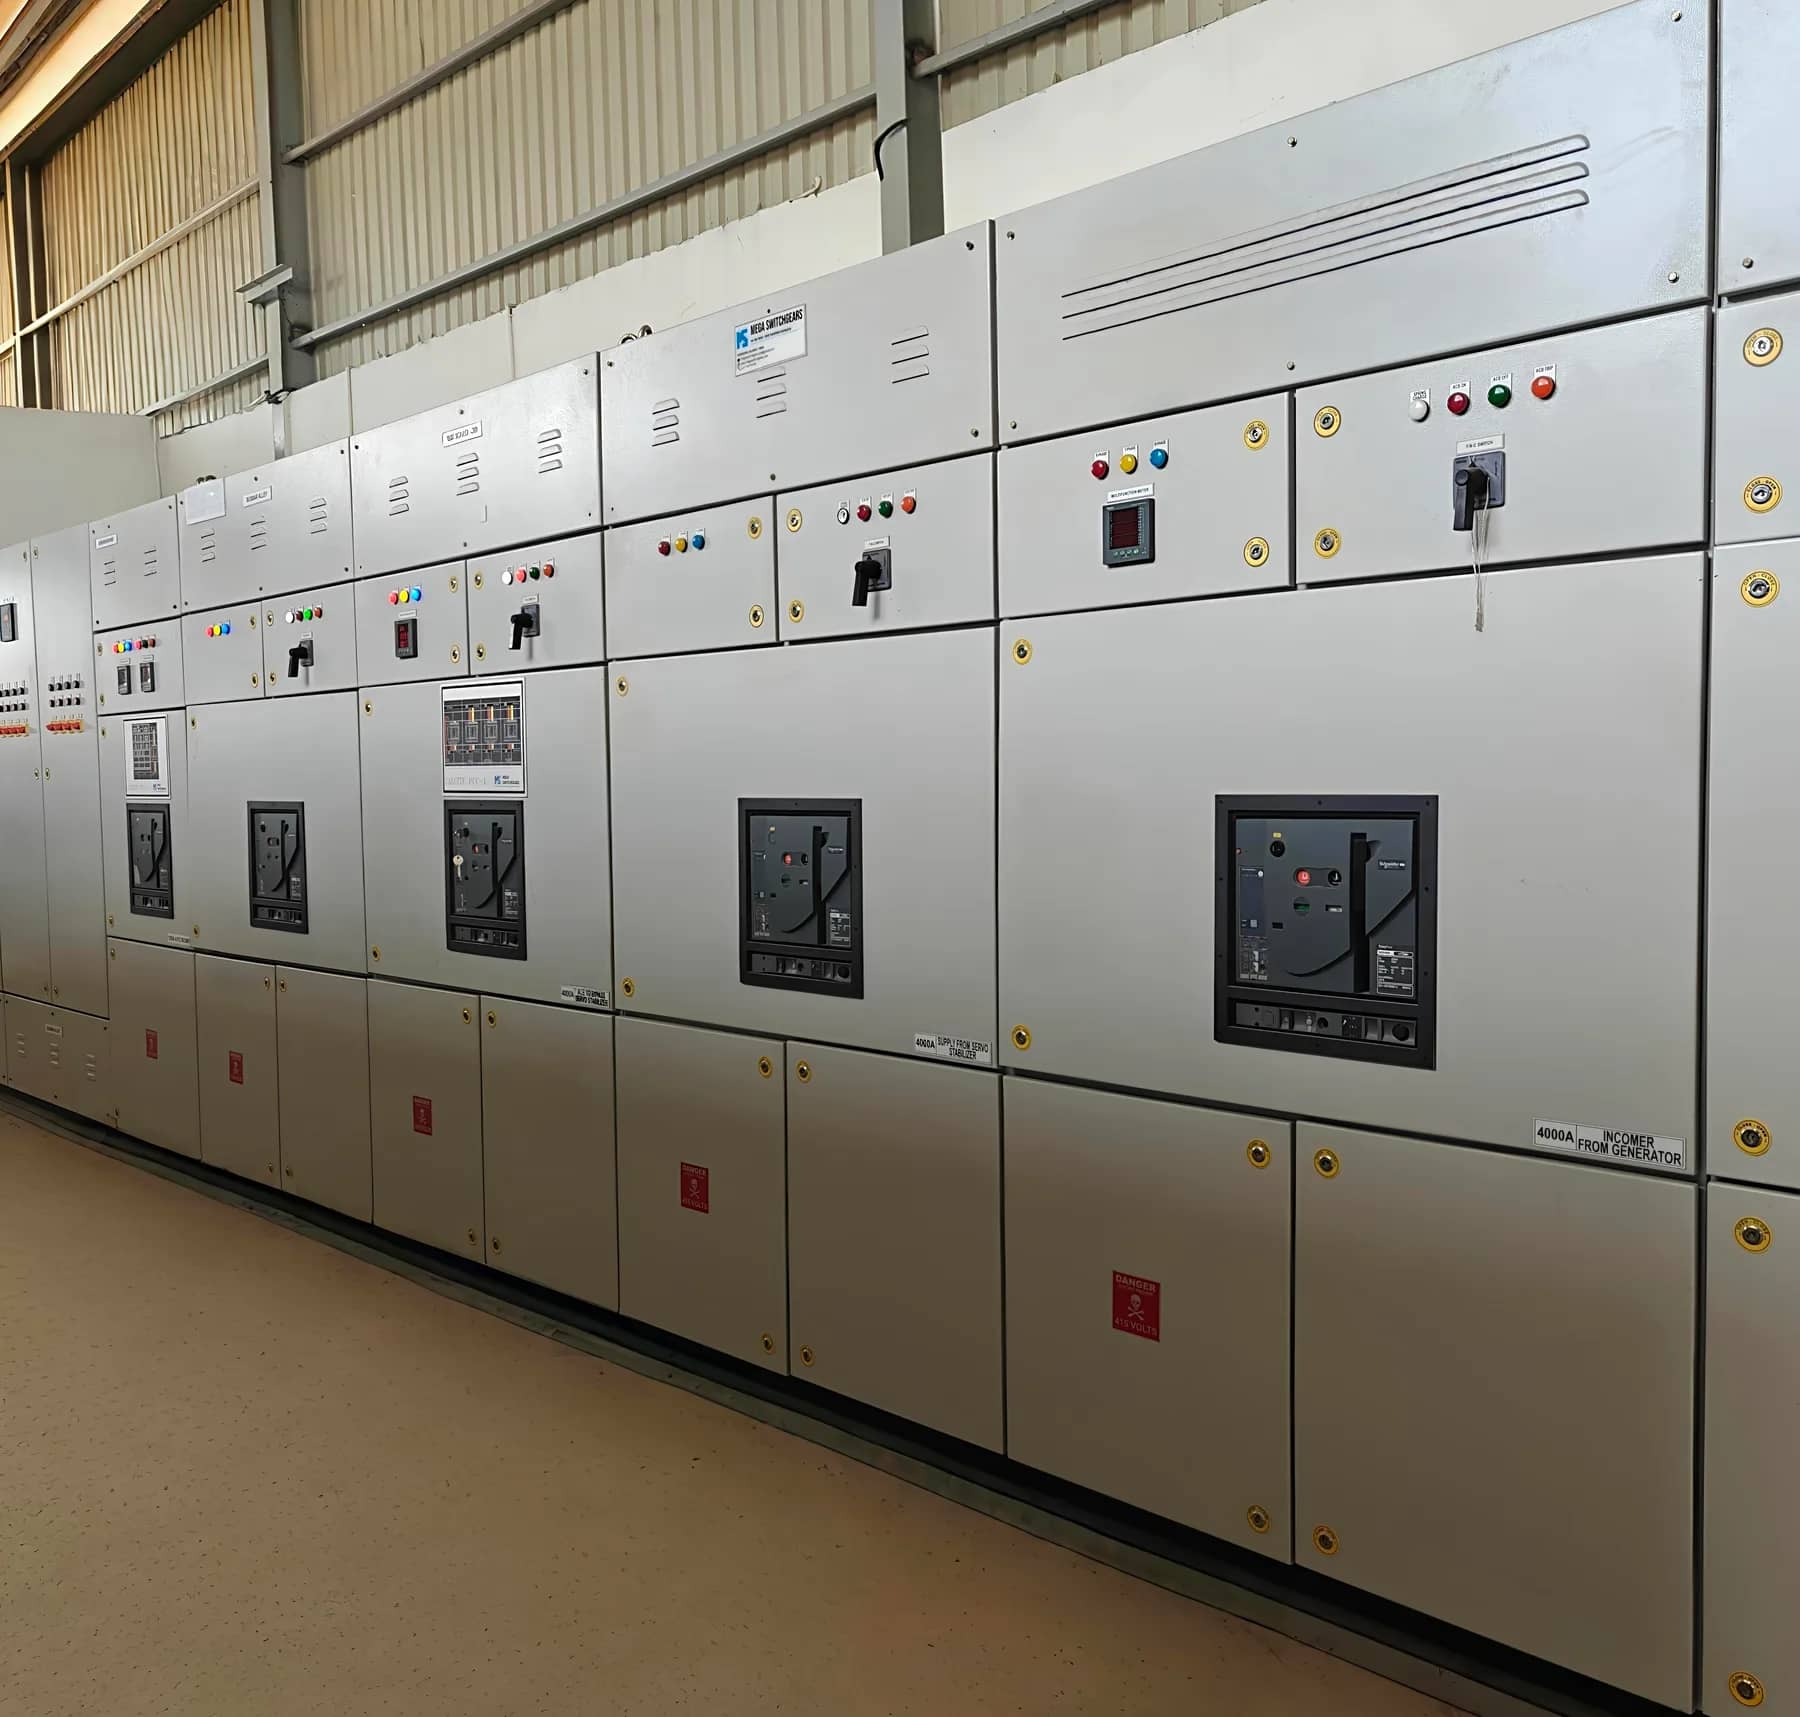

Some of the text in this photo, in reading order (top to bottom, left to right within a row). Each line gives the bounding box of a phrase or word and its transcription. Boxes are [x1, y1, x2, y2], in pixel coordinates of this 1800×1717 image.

[751, 321, 765, 335] MEGA
[766, 309, 803, 331] SWITCHGEARS
[916, 1038, 935, 1048] 4000A
[938, 1036, 988, 1053] SUPPLY FROM SERVO
[949, 1048, 976, 1060] STABILIZER
[1537, 1126, 1574, 1143] 4000A
[1603, 1129, 1655, 1149] INCOMER
[1578, 1138, 1682, 1165] FROM GENERATOR
[1115, 1274, 1156, 1293] DANGER
[1114, 1317, 1157, 1337] 415 VOLTS
